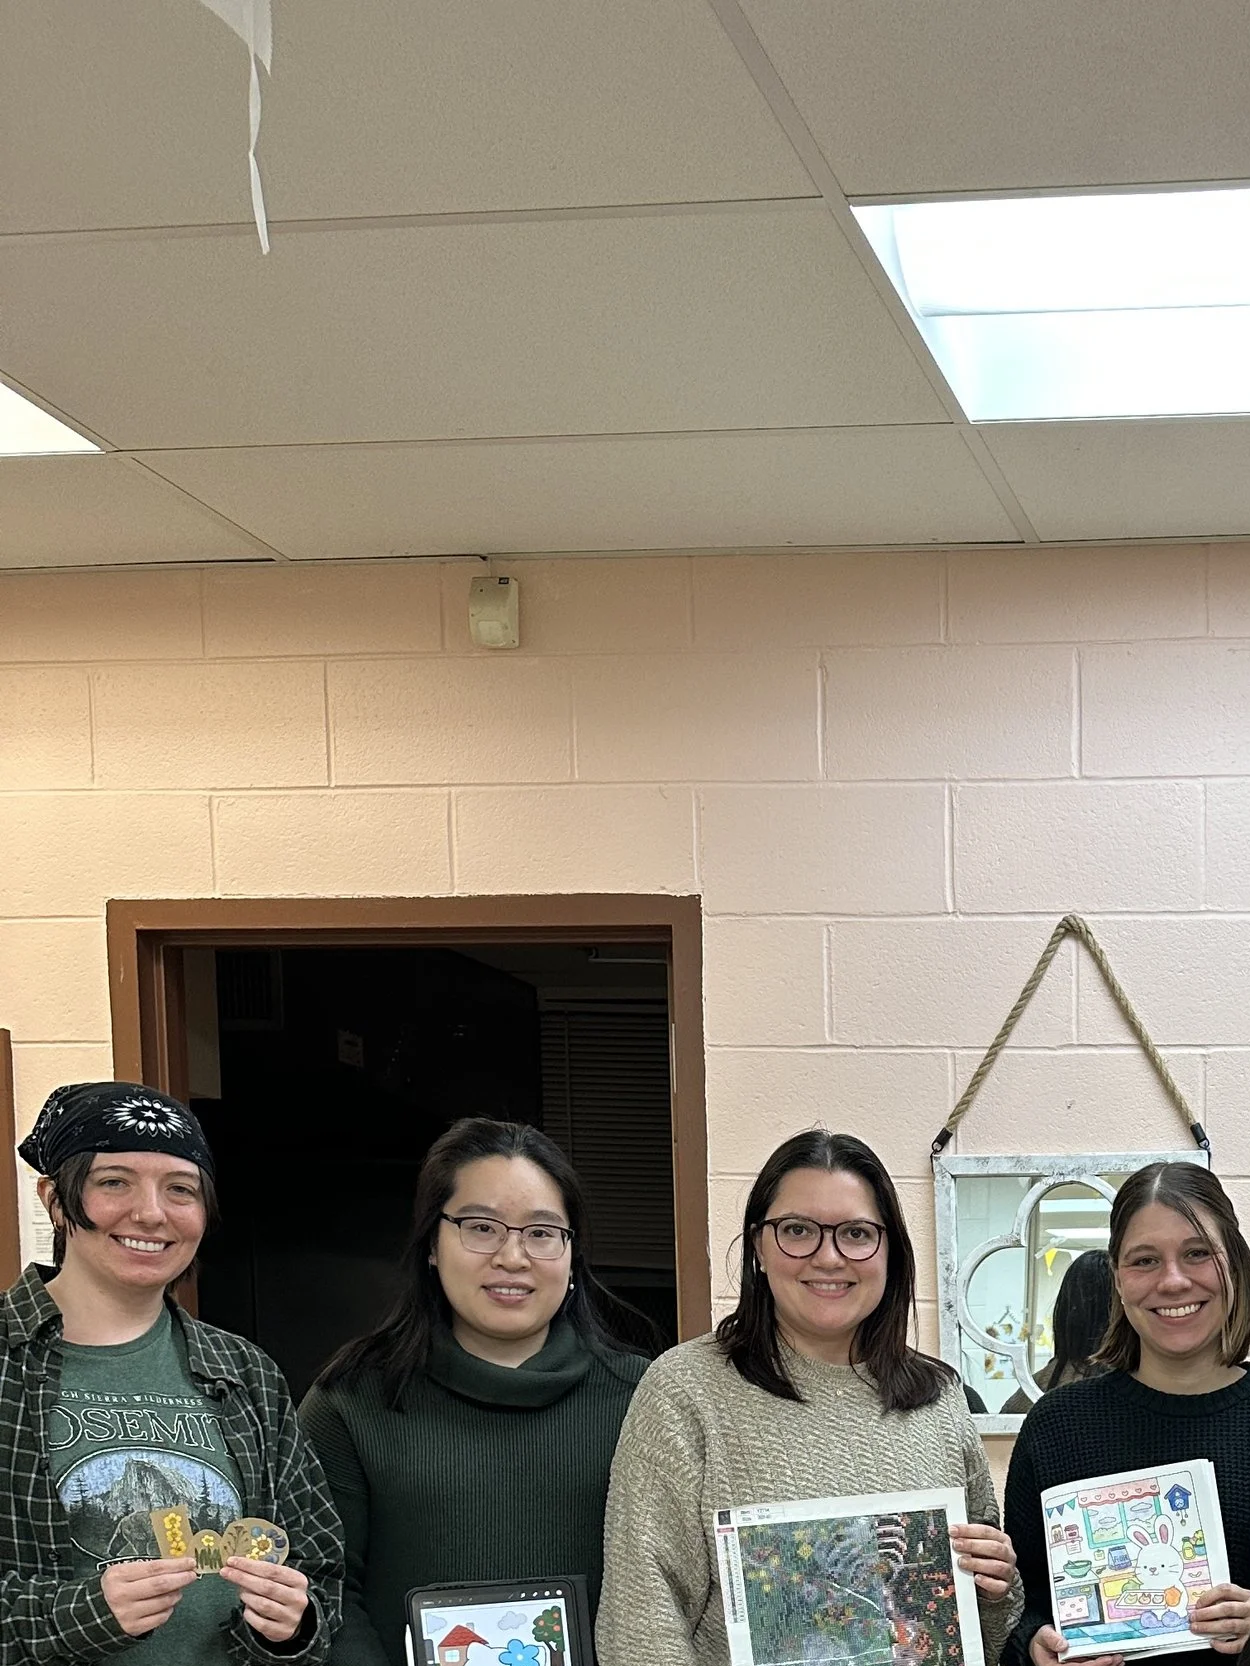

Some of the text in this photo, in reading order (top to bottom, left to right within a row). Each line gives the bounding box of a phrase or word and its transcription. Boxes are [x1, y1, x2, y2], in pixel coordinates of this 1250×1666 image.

[61, 1389, 204, 1406] GH SIERRA WILDERNESS
